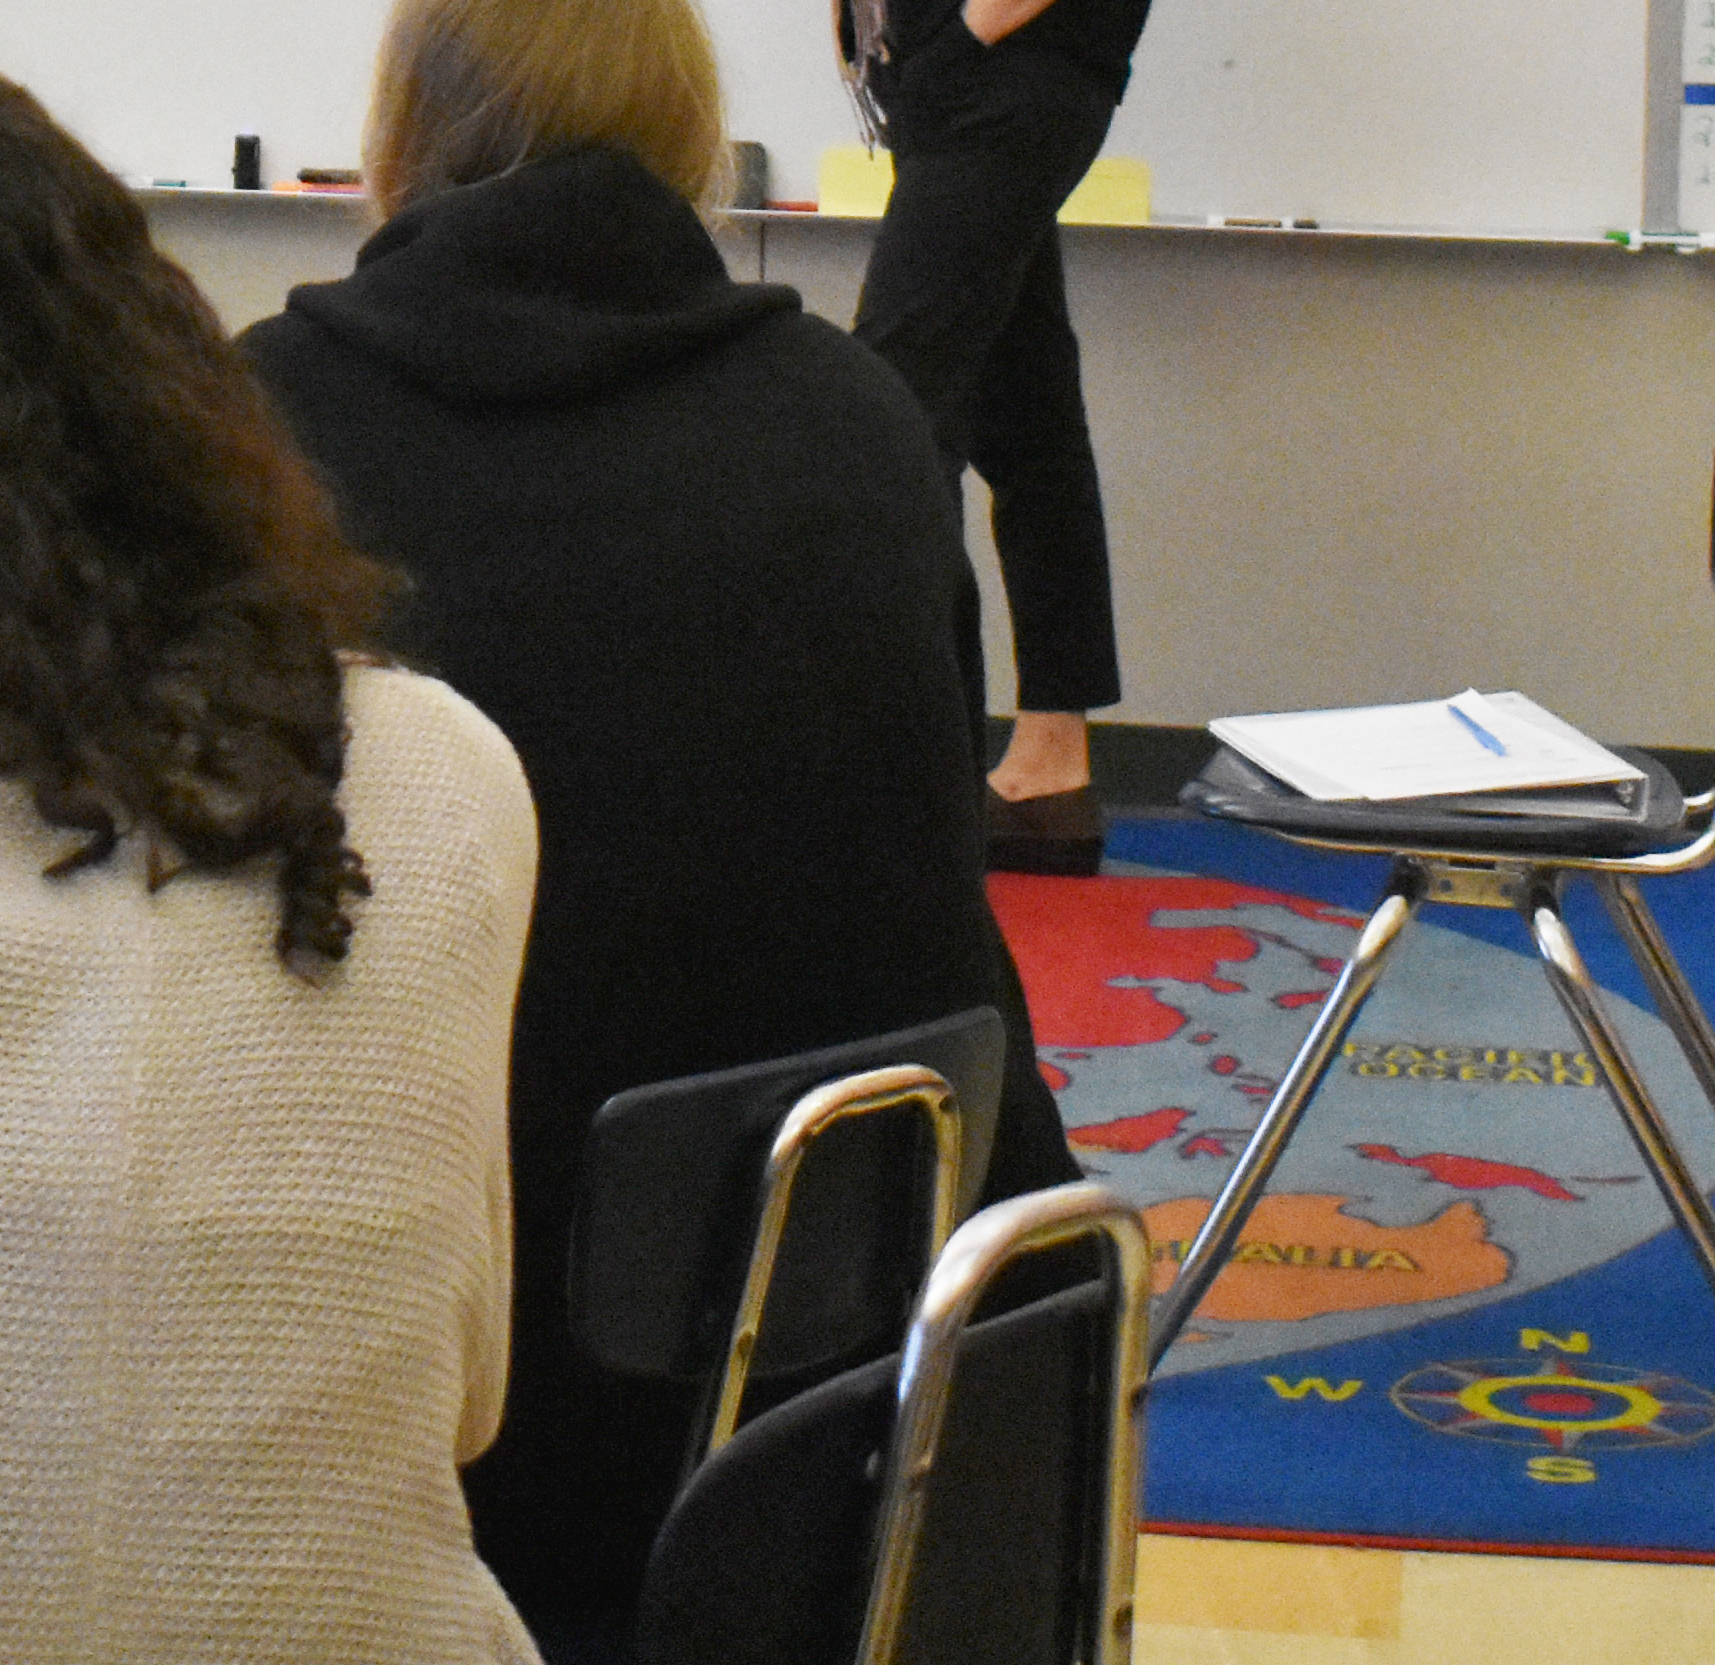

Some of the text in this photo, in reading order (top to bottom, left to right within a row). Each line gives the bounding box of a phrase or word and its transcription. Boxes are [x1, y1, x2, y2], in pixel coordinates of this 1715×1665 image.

[1356, 1061, 1598, 1087] OCEAN
[1520, 1328, 1590, 1353] N
[1264, 1375, 1364, 1401] W
[1526, 1456, 1597, 1484] S
